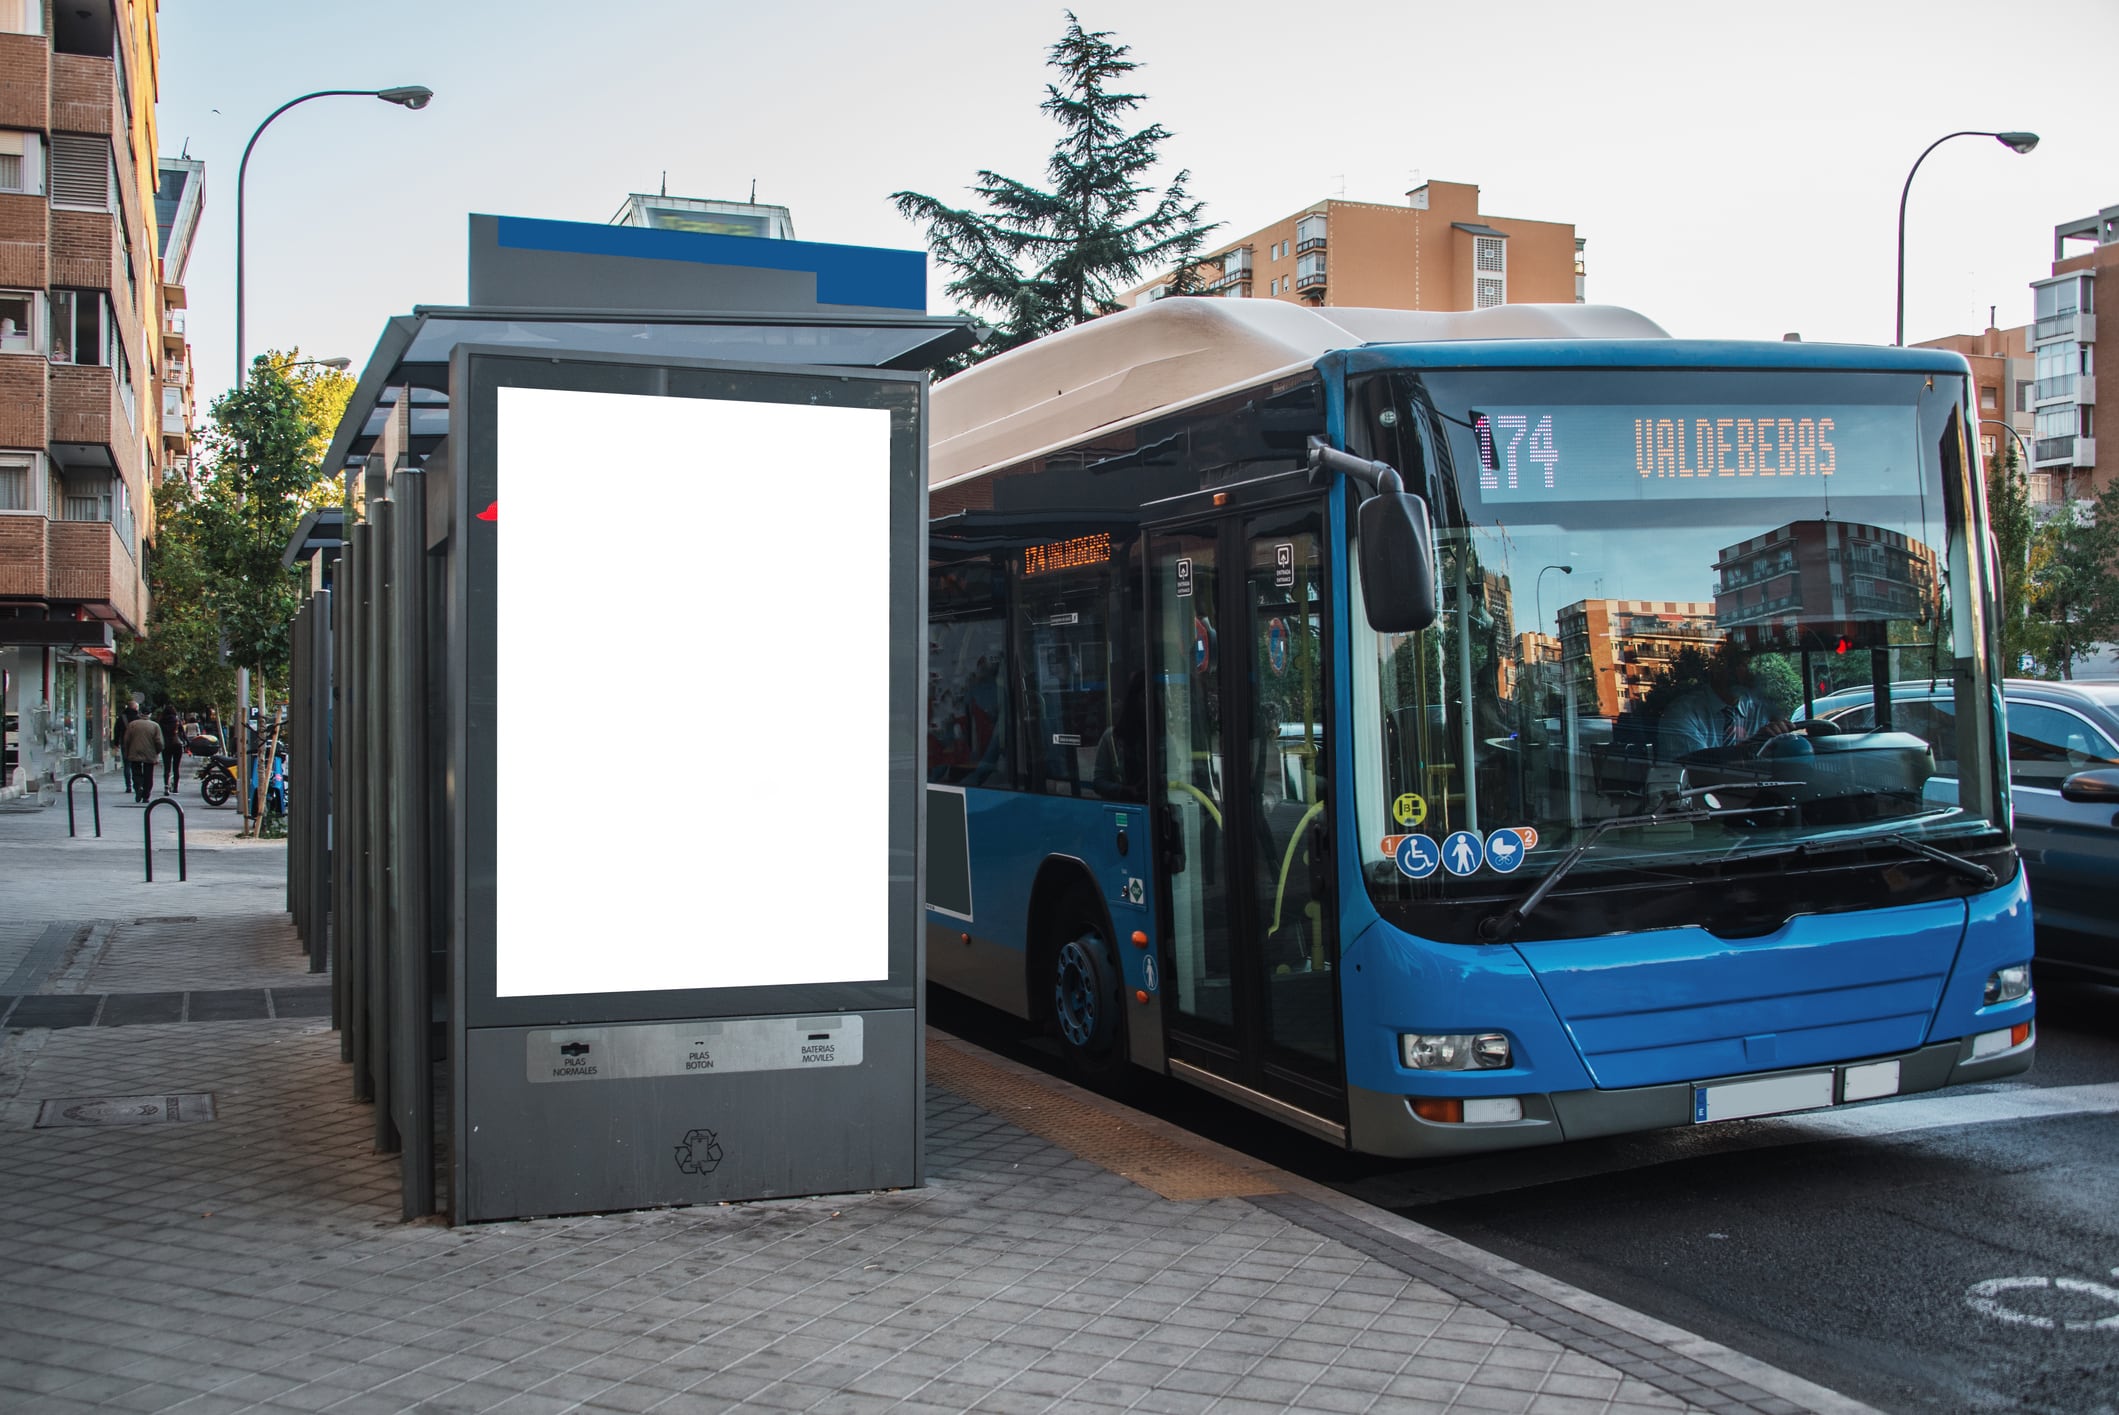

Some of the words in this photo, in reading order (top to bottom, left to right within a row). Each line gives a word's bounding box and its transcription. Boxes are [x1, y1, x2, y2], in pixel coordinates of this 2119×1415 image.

[1475, 415, 1558, 488] 174
[1635, 418, 1836, 478] VALDEBEBAS
[251, 707, 259, 716] P
[1524, 829, 1533, 843] 2
[1385, 838, 1392, 851] 1
[801, 1045, 835, 1054] BATERIAS
[689, 1051, 710, 1061] PILAS
[802, 1053, 834, 1063] MOVILES
[564, 1058, 586, 1067] PILAS
[685, 1060, 714, 1070] BOTON
[553, 1066, 598, 1077] NORMALES
